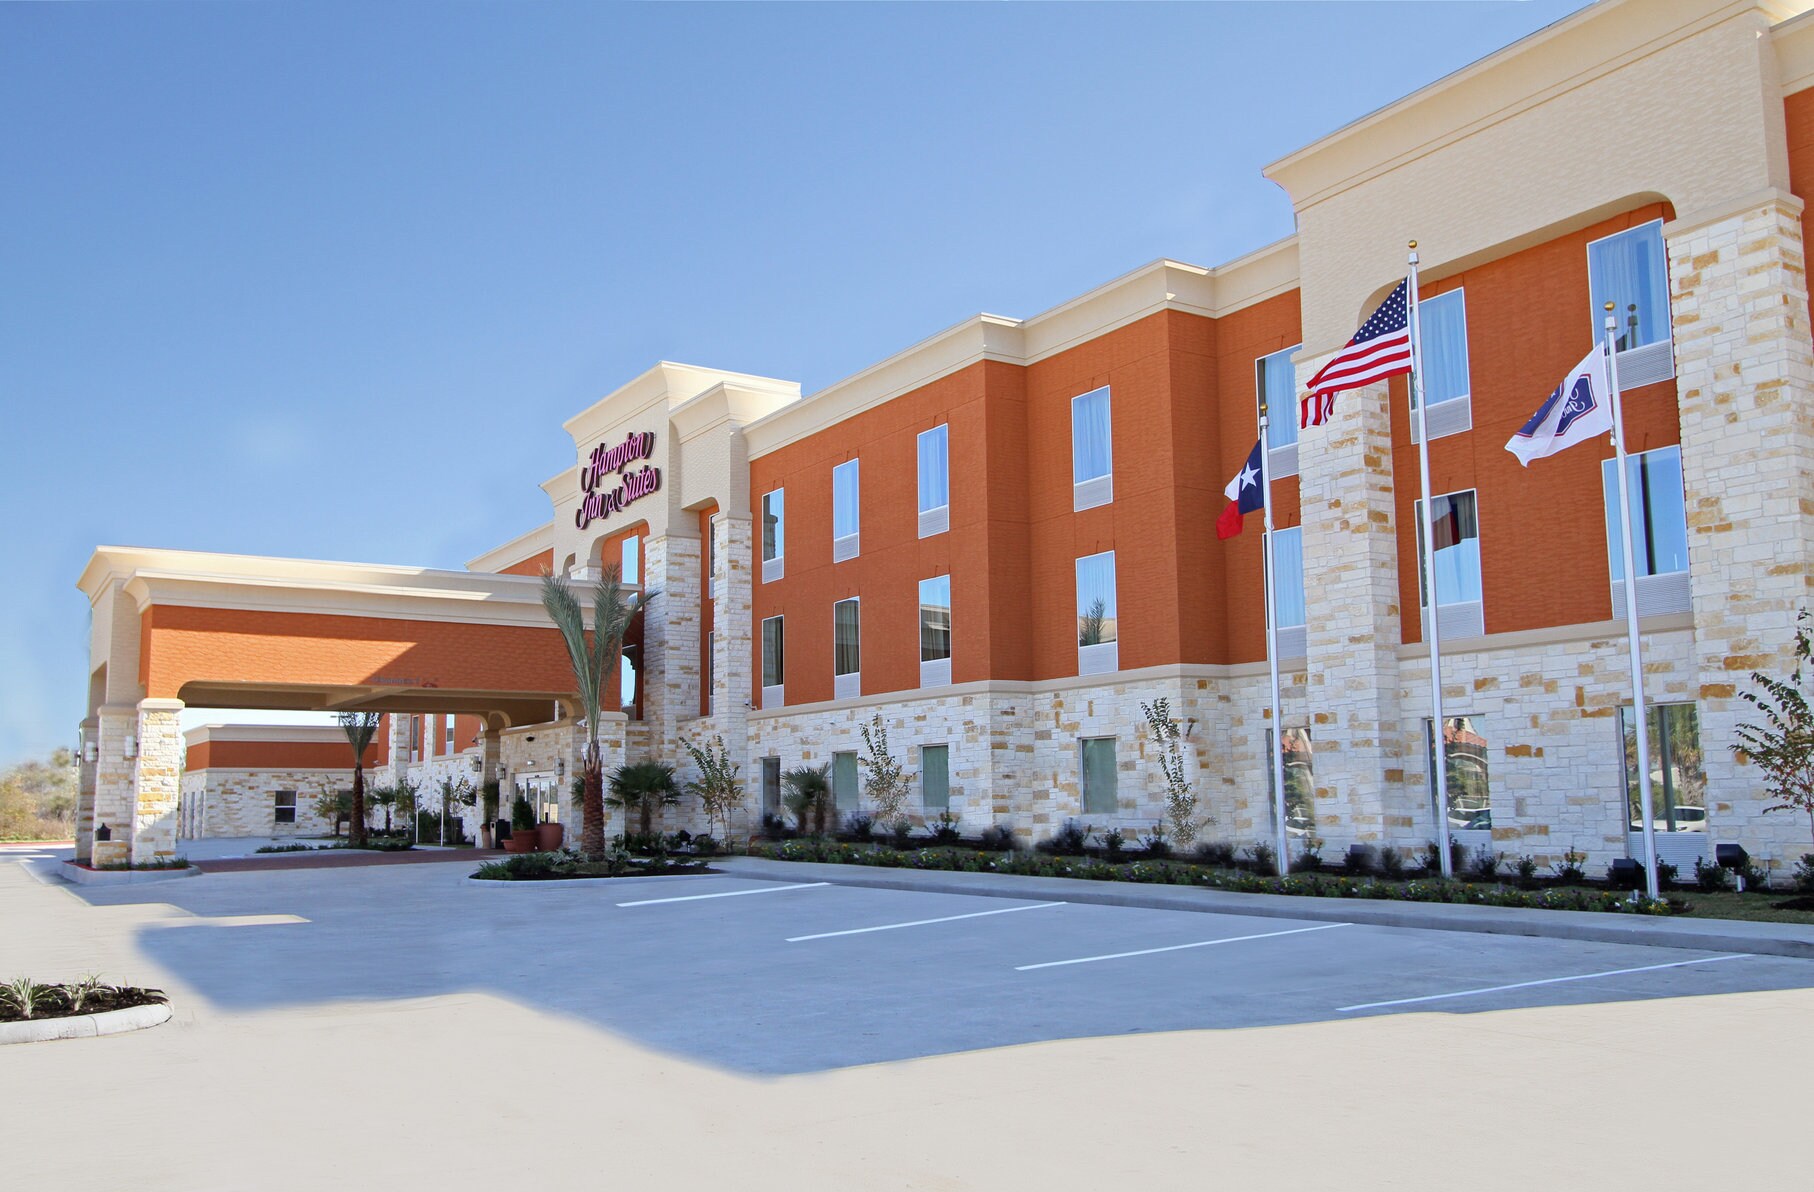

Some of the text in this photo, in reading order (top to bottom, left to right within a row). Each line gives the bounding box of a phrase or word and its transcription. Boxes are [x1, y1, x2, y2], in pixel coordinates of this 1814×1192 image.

[581, 432, 655, 493] Hampton
[576, 465, 661, 530] Inn & Suites
